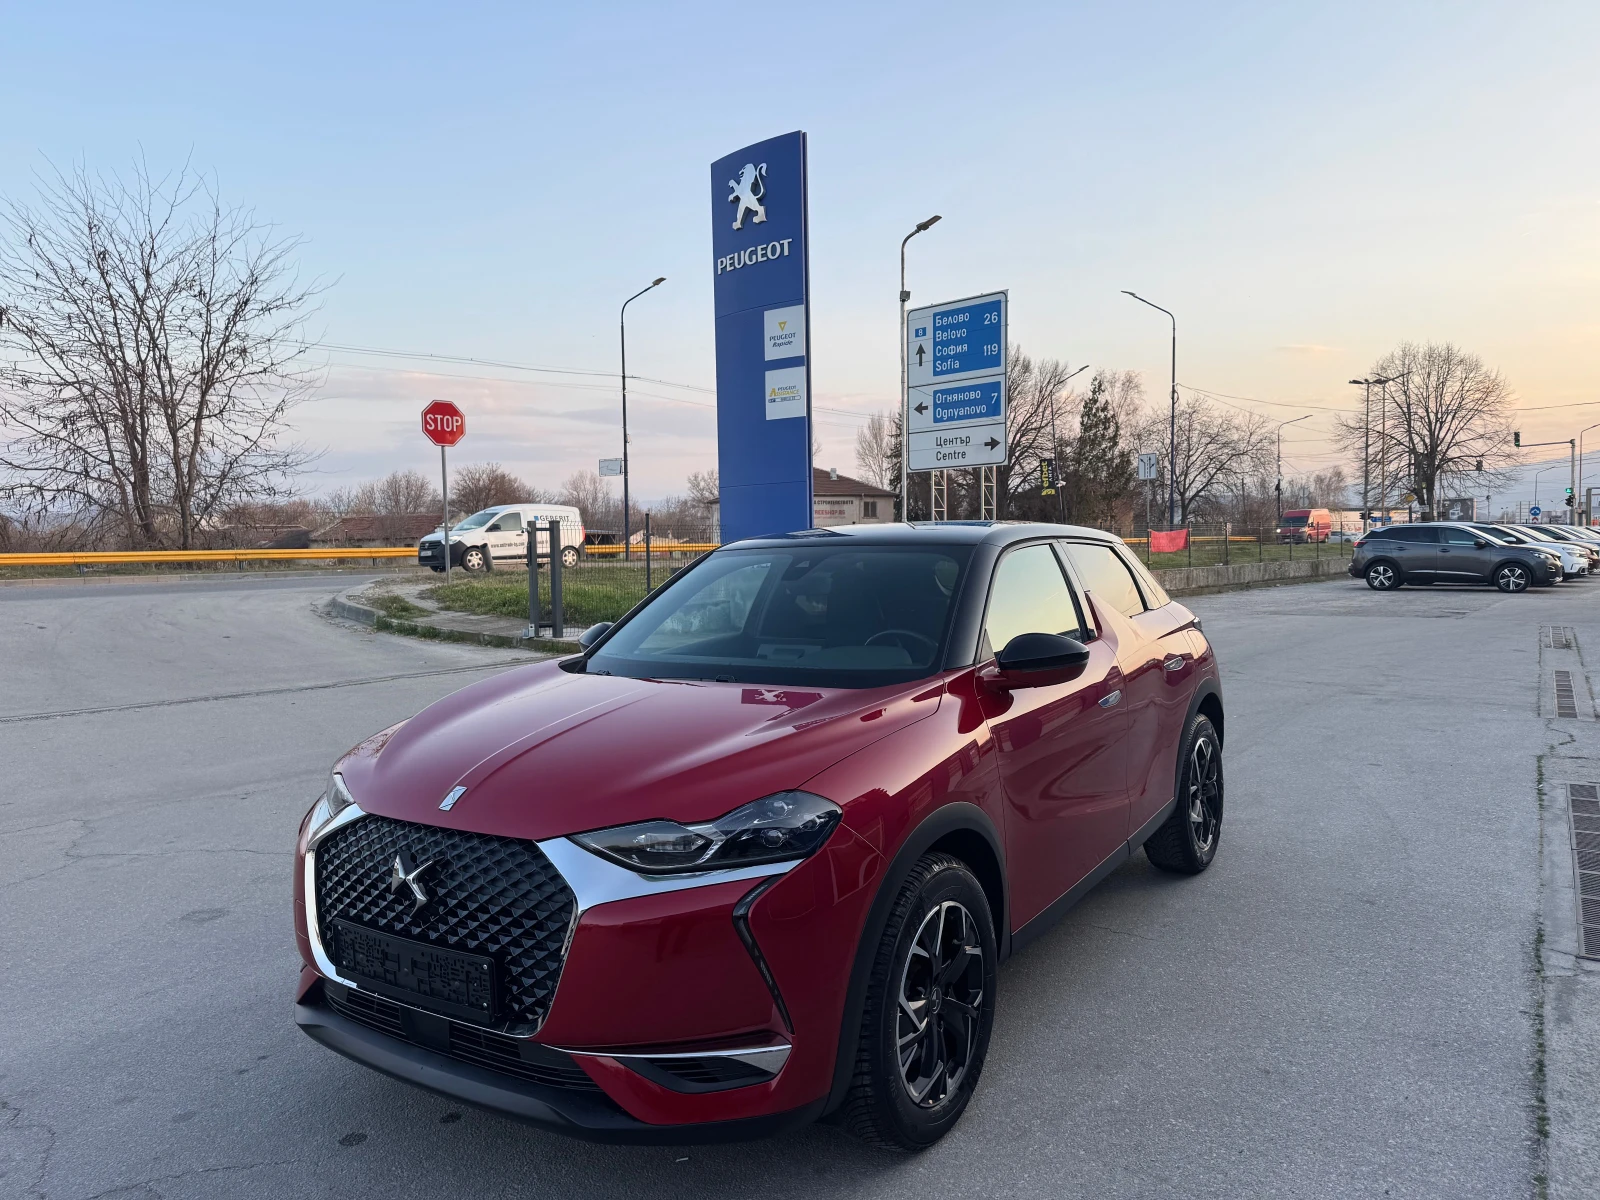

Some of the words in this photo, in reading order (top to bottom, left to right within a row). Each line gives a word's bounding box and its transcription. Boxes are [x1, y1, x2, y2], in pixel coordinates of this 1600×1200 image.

[717, 238, 793, 275] PEUGEOT
[935, 312, 970, 327] Белово
[983, 312, 999, 325] 26
[769, 332, 796, 342] PEUGEOT
[918, 328, 923, 337] 8
[935, 328, 967, 342] Belovo
[935, 343, 968, 357] София
[983, 343, 999, 356] 119
[935, 358, 960, 372] Sofia
[935, 390, 982, 404] Огняново
[990, 392, 998, 404] 7
[935, 404, 987, 420] Ognyanovo
[426, 413, 462, 432] STOP
[935, 435, 971, 448] Център
[935, 450, 967, 461] Centre
